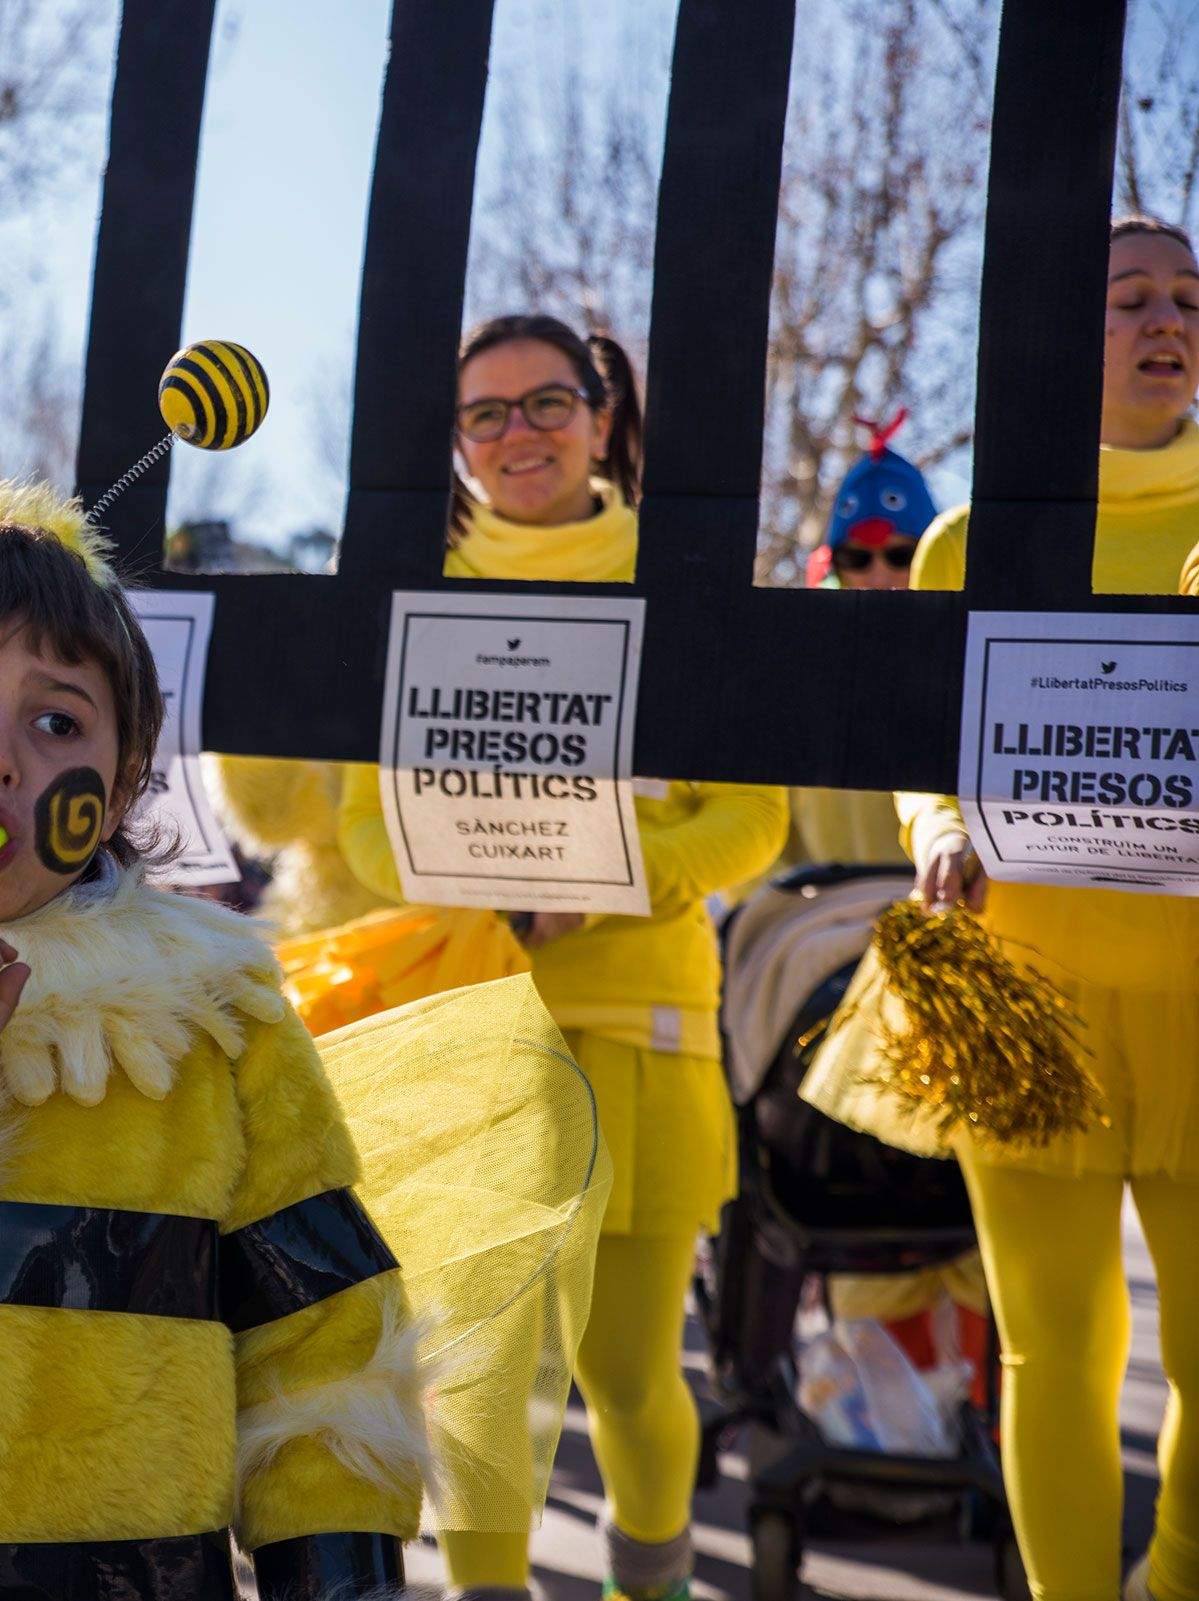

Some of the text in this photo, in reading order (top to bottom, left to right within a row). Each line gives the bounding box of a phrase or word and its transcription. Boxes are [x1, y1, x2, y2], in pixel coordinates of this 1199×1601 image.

[407, 686, 612, 727] LLIBERTAT
[424, 727, 588, 767] PRESOS
[993, 723, 1199, 762] LLIBERTA
[412, 765, 598, 802] POLÍTICS
[1012, 769, 1194, 808] PRESOS
[1002, 809, 1199, 835] POLÍTICS
[468, 844, 565, 861] CUIXART
[1025, 844, 1199, 865] FUTUR DE LLIBERTA
[1047, 836, 1179, 854] CONSTRUIM UN
